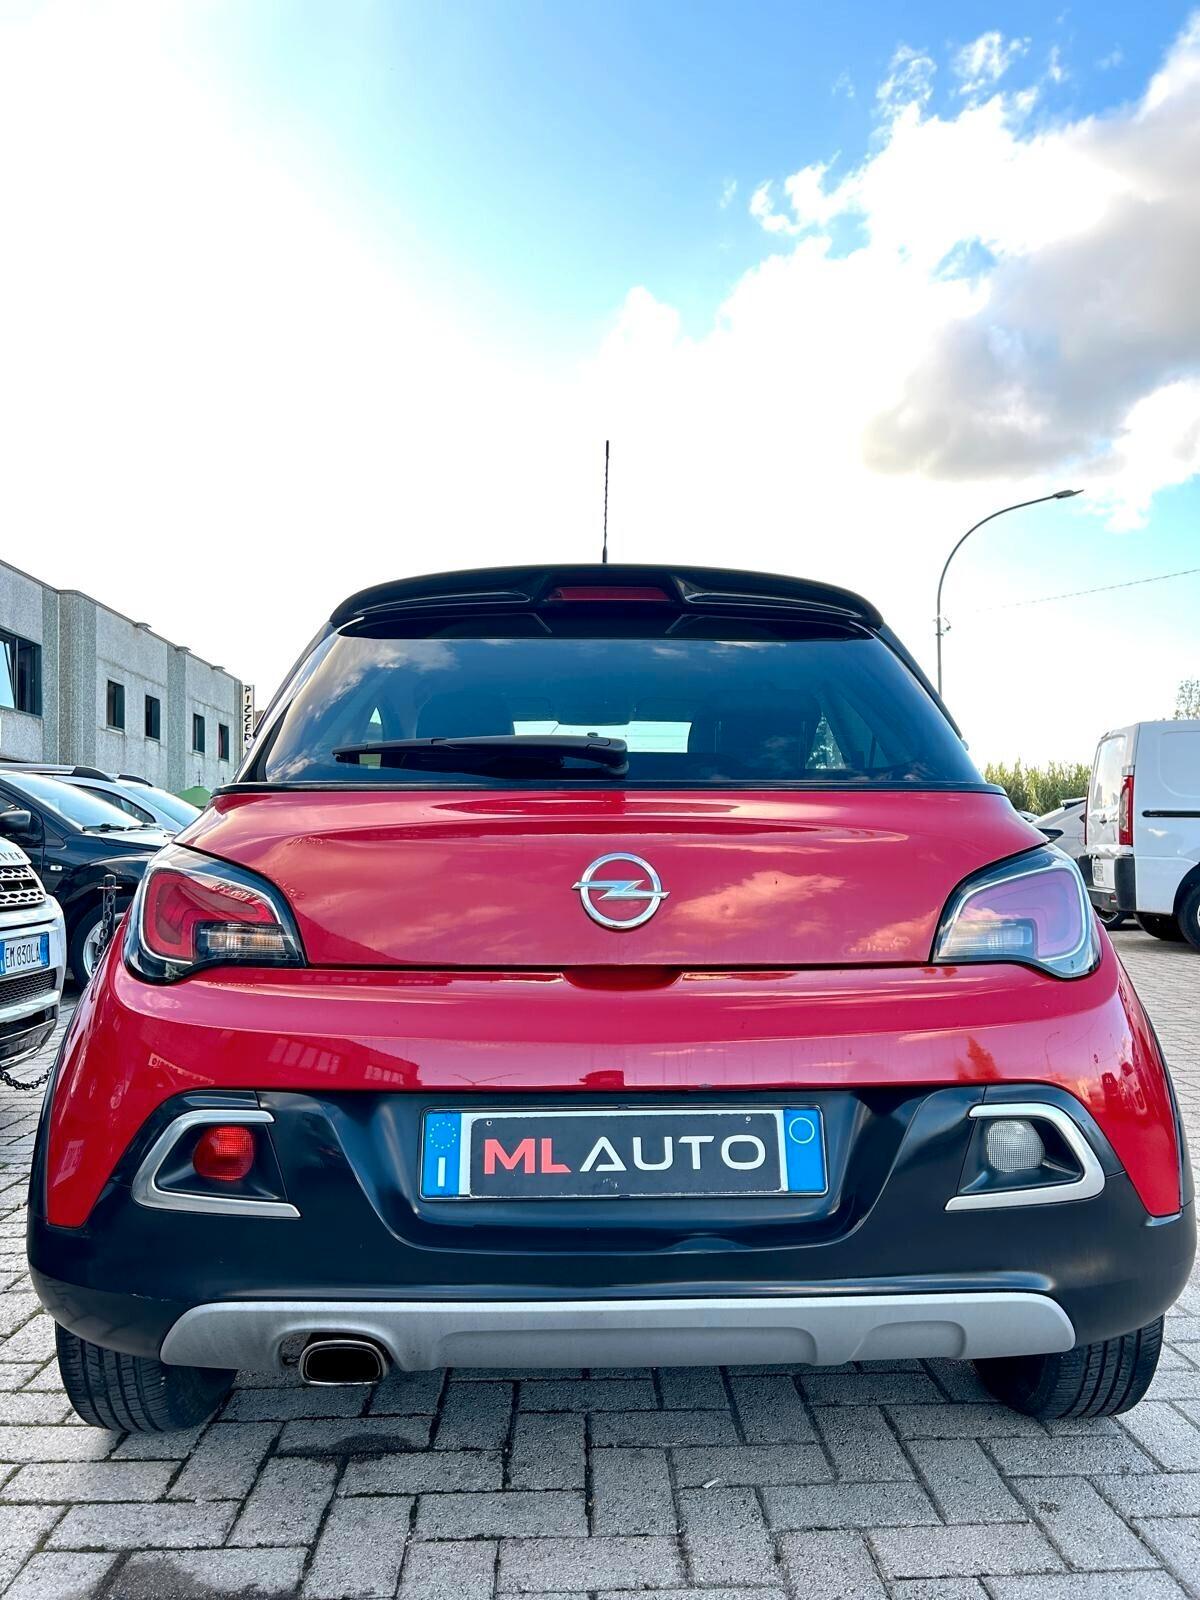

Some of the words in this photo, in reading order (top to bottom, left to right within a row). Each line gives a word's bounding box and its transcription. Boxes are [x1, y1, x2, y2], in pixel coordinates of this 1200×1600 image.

[244, 685, 252, 750] PIZZER
[484, 1138, 572, 1175] ML
[579, 1135, 766, 1172] AUTO
